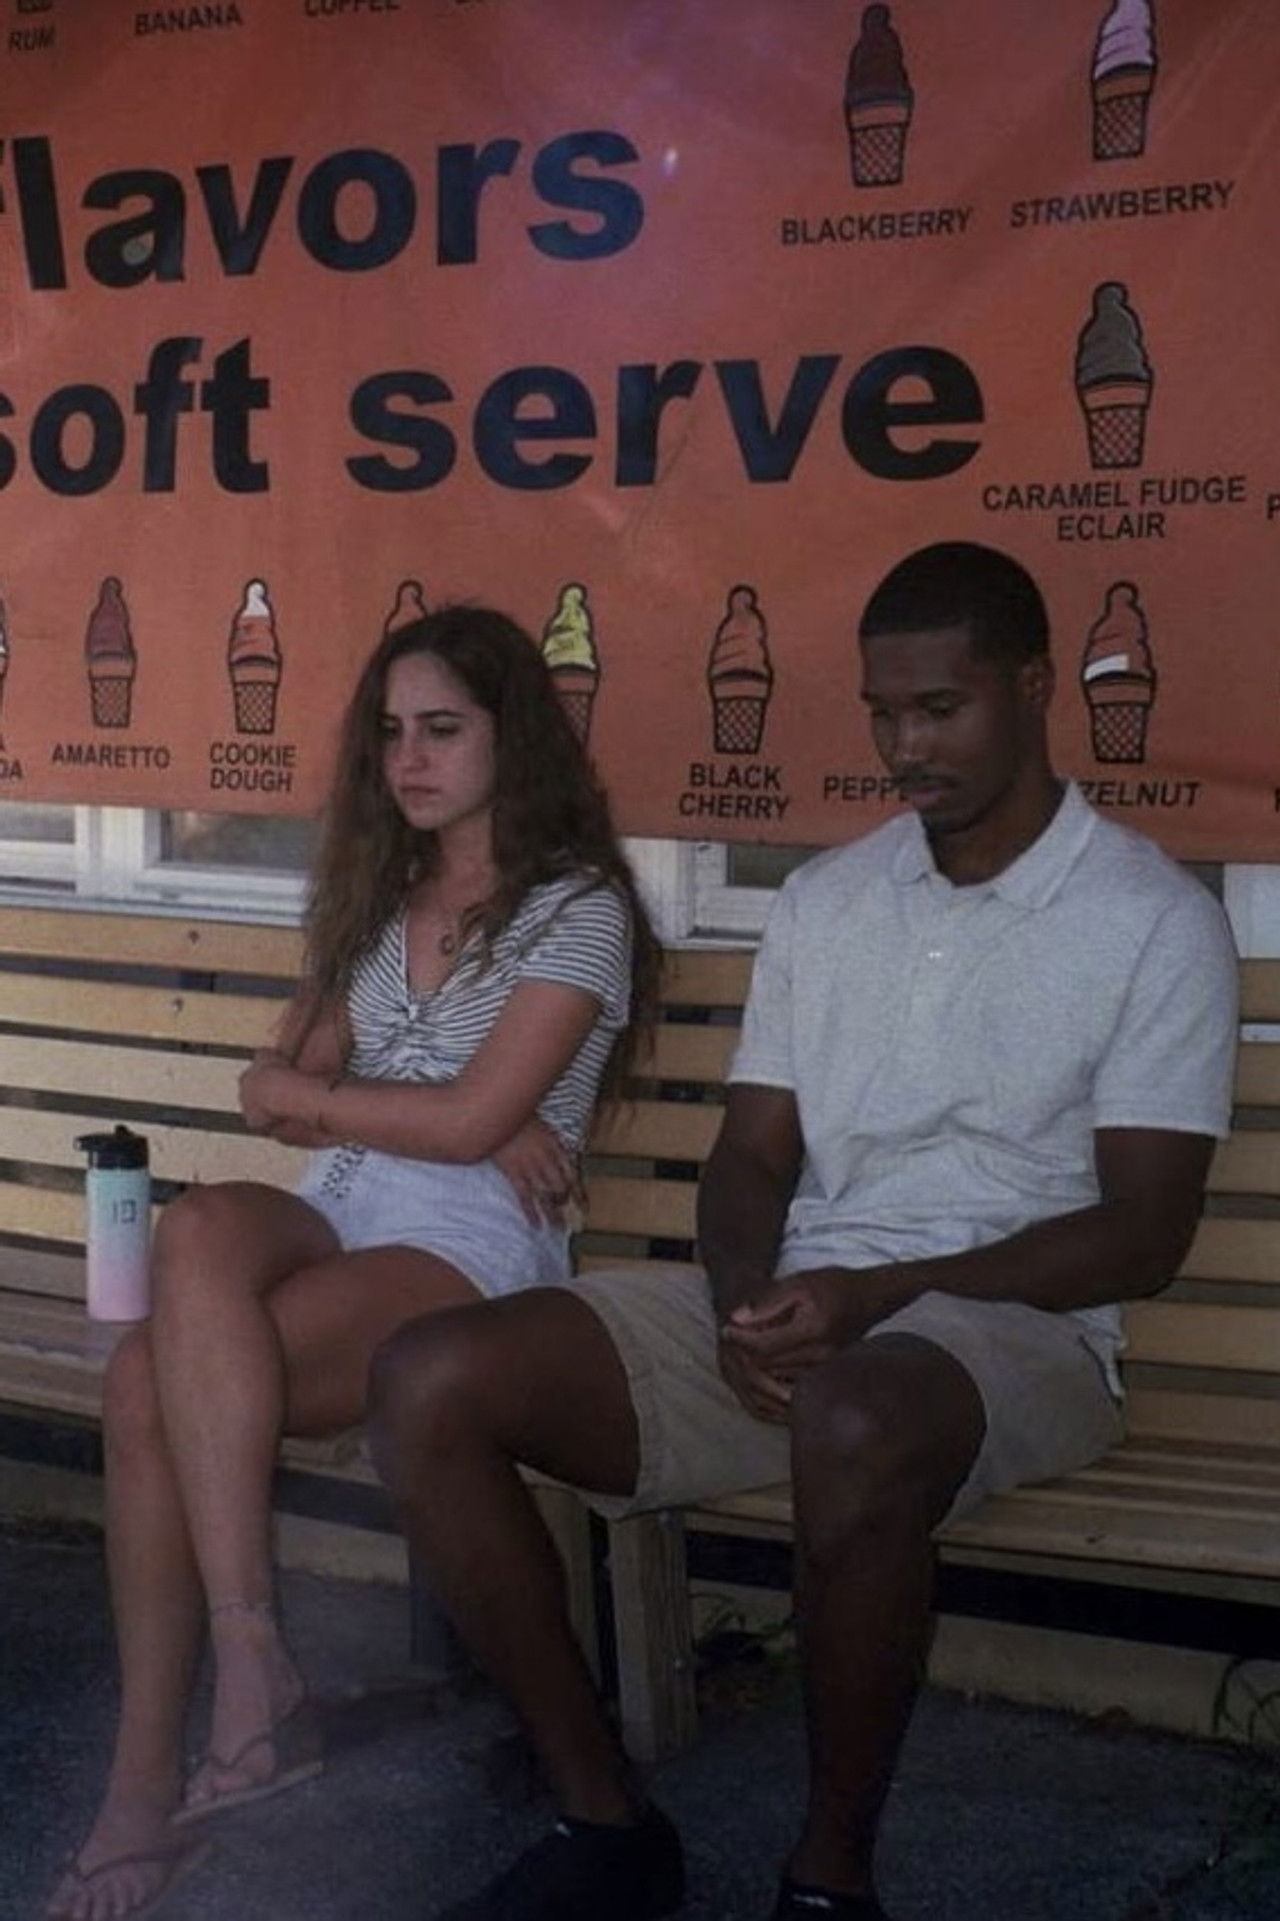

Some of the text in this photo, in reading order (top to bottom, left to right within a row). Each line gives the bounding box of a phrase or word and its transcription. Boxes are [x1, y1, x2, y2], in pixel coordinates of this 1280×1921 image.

[134, 3, 243, 36] BANANA
[8, 26, 56, 51] RUM
[0, 131, 642, 290] lavors
[1009, 181, 1234, 229] STRAWBERRY
[781, 206, 973, 246] BLACKBERRY
[0, 336, 985, 496] oft serve
[982, 476, 1246, 511] CARAMEL FUDGE
[1057, 512, 1166, 541] ECLAIR
[51, 743, 171, 769] AMARETTO
[209, 742, 297, 767] COOKIE
[210, 768, 292, 792] DOUGH
[689, 763, 782, 791] BLACK
[823, 775, 908, 802] PEPP
[679, 792, 790, 819] CHERRY
[1077, 780, 1201, 807] ZELNUT
